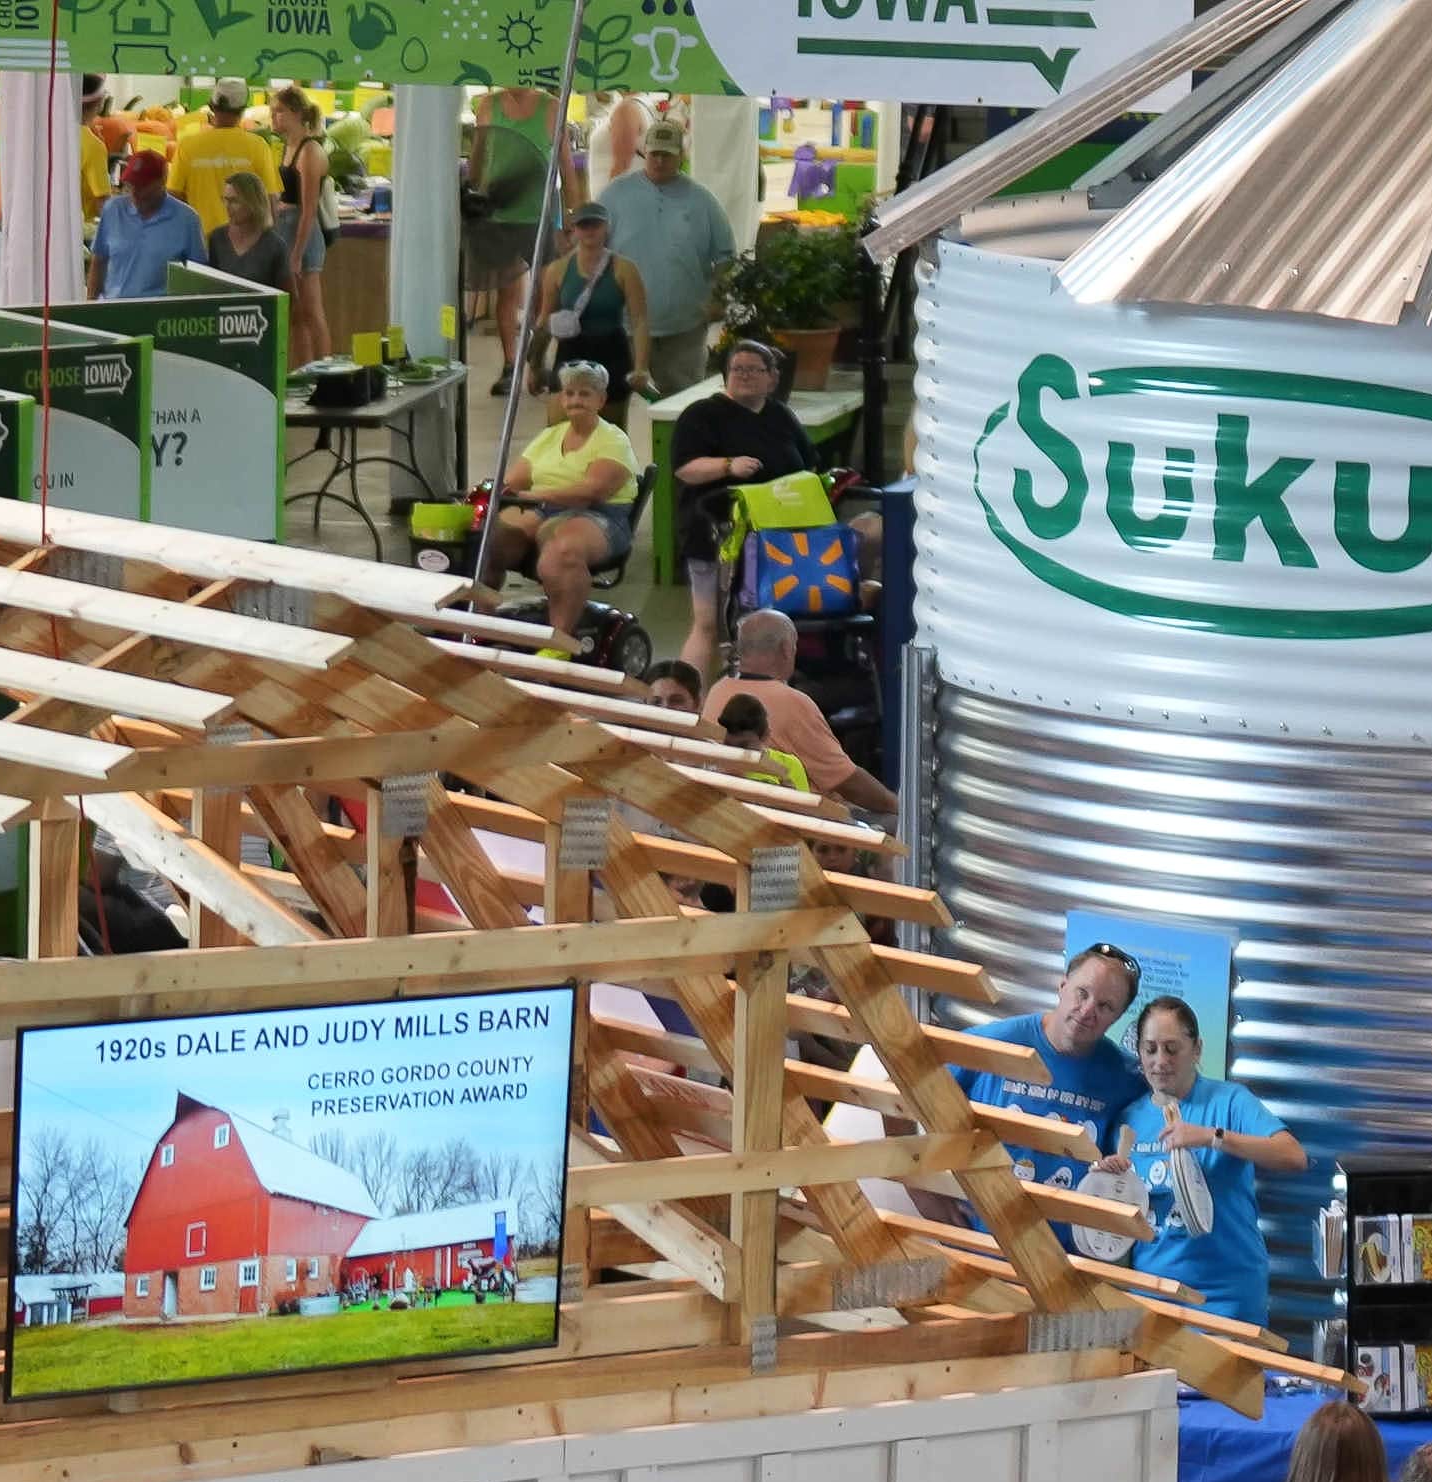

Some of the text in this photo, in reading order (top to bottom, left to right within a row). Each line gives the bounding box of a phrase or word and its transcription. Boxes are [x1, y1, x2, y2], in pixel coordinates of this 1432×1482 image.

[267, 8, 331, 35] IOWA
[158, 315, 259, 337] CHOOSE IOWA
[25, 364, 123, 389] CHOOSE IOWA
[191, 408, 201, 424] A
[59, 472, 74, 488] IN
[95, 1004, 550, 1064] 1920s DALE AND JUDY MILLS BARN
[308, 1055, 534, 1091] CERRO GORDO COUNTY
[311, 1083, 527, 1117] PRESERVATION AWARD
